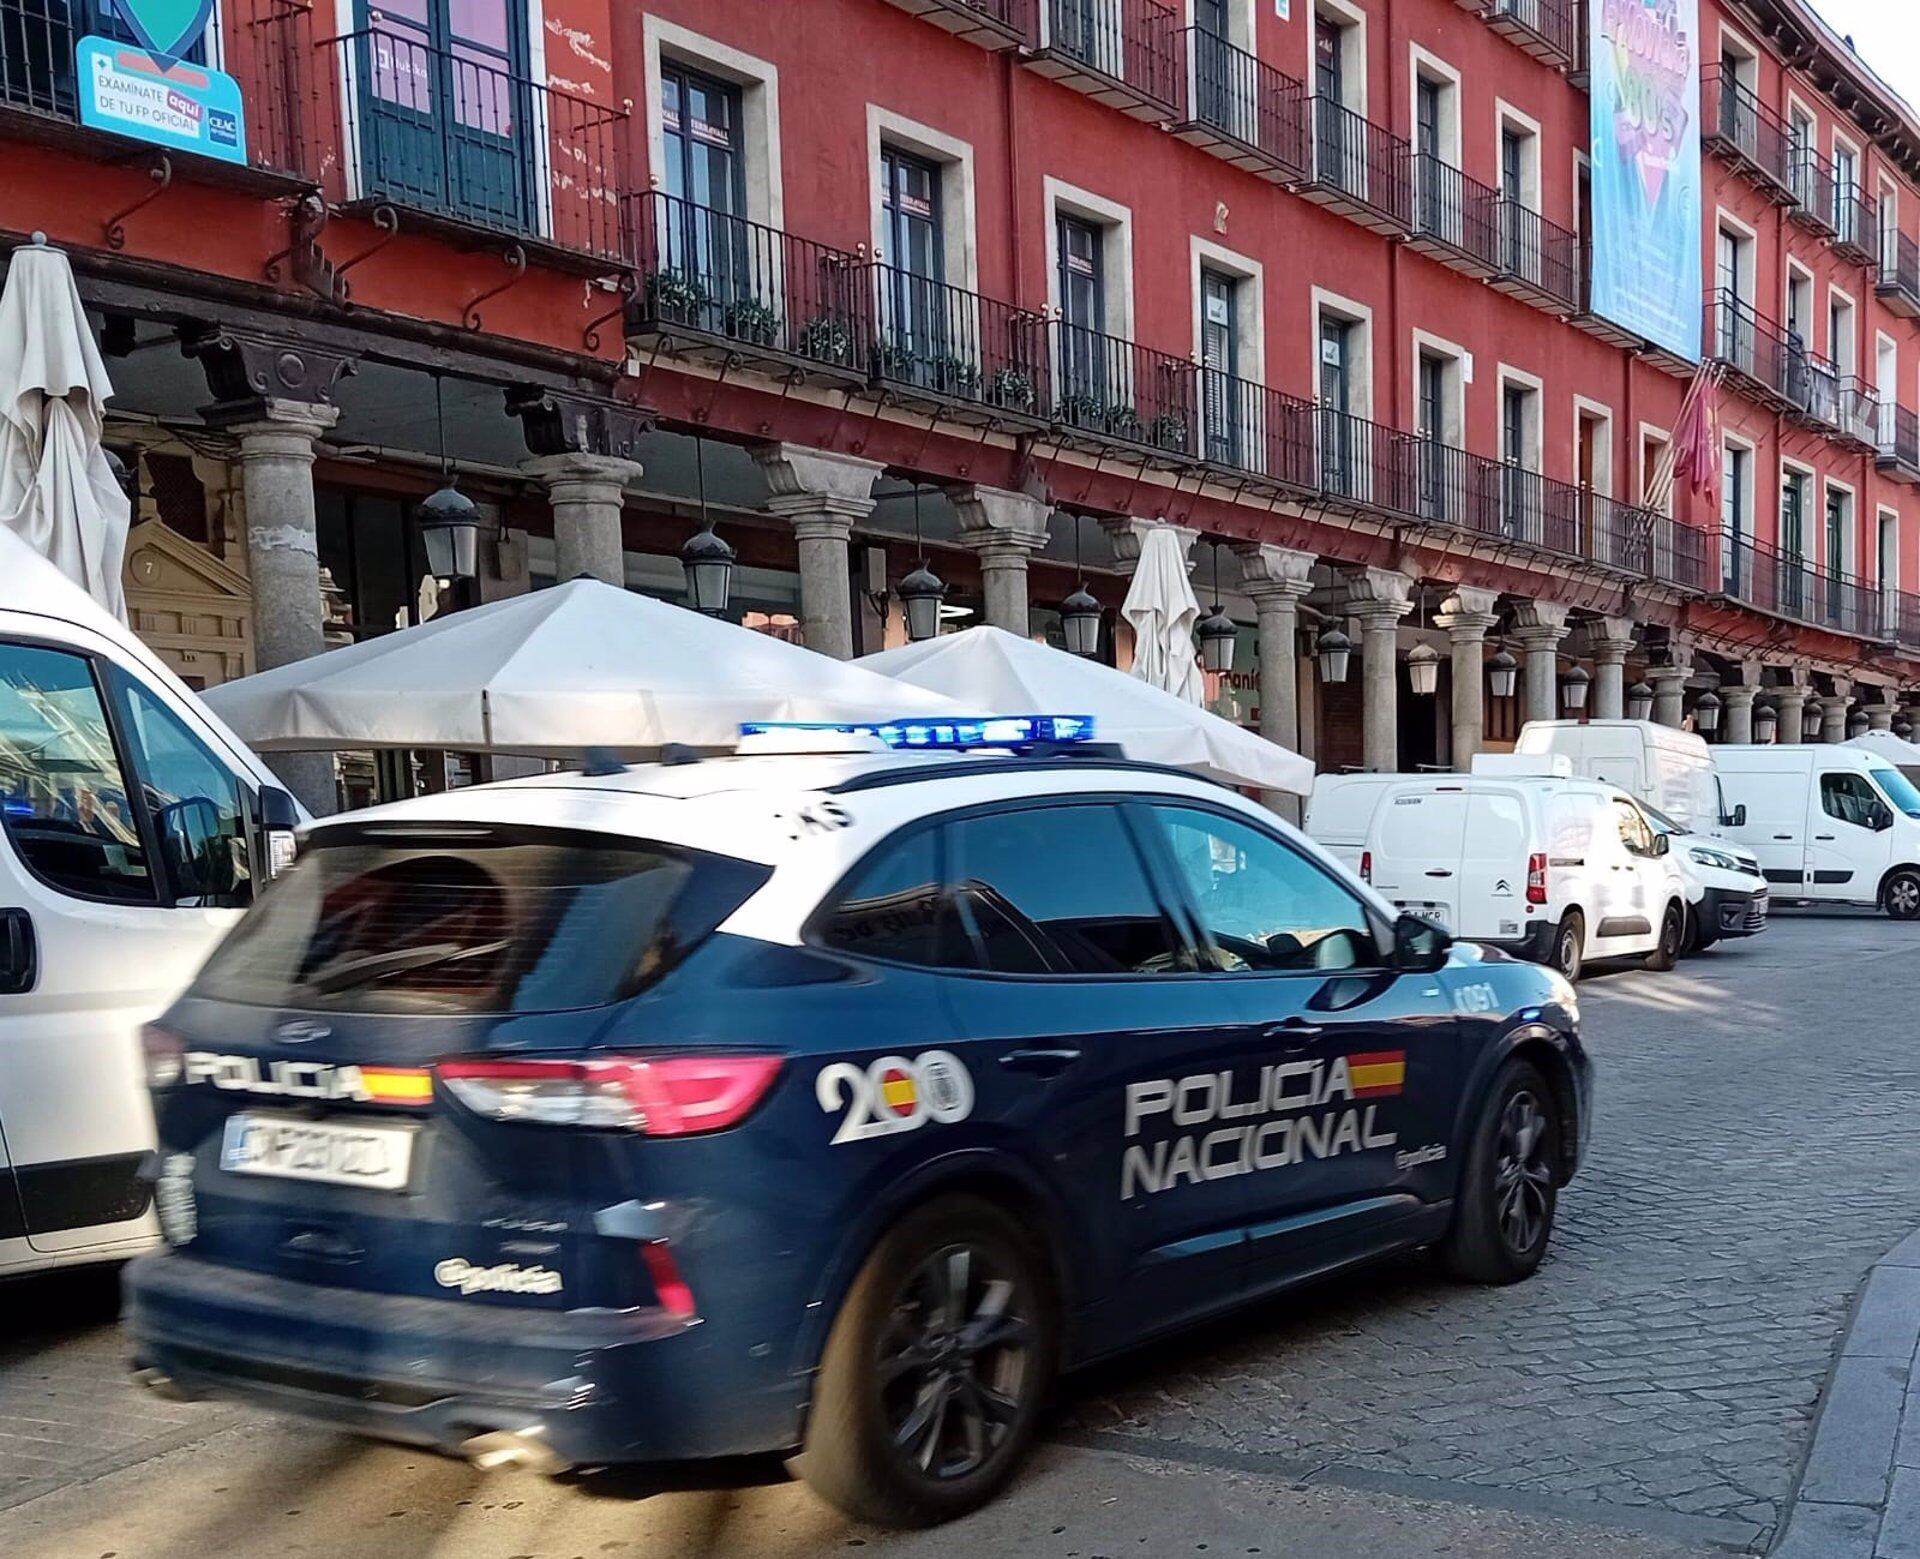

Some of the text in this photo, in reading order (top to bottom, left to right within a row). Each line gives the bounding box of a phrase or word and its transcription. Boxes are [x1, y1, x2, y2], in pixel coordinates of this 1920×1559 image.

[100, 96, 195, 131] DE TU FP OFICIAL
[209, 116, 236, 131] CEAC
[146, 562, 153, 574] 7
[815, 1050, 975, 1146] 200
[1120, 1105, 1398, 1200] NACIONAL
